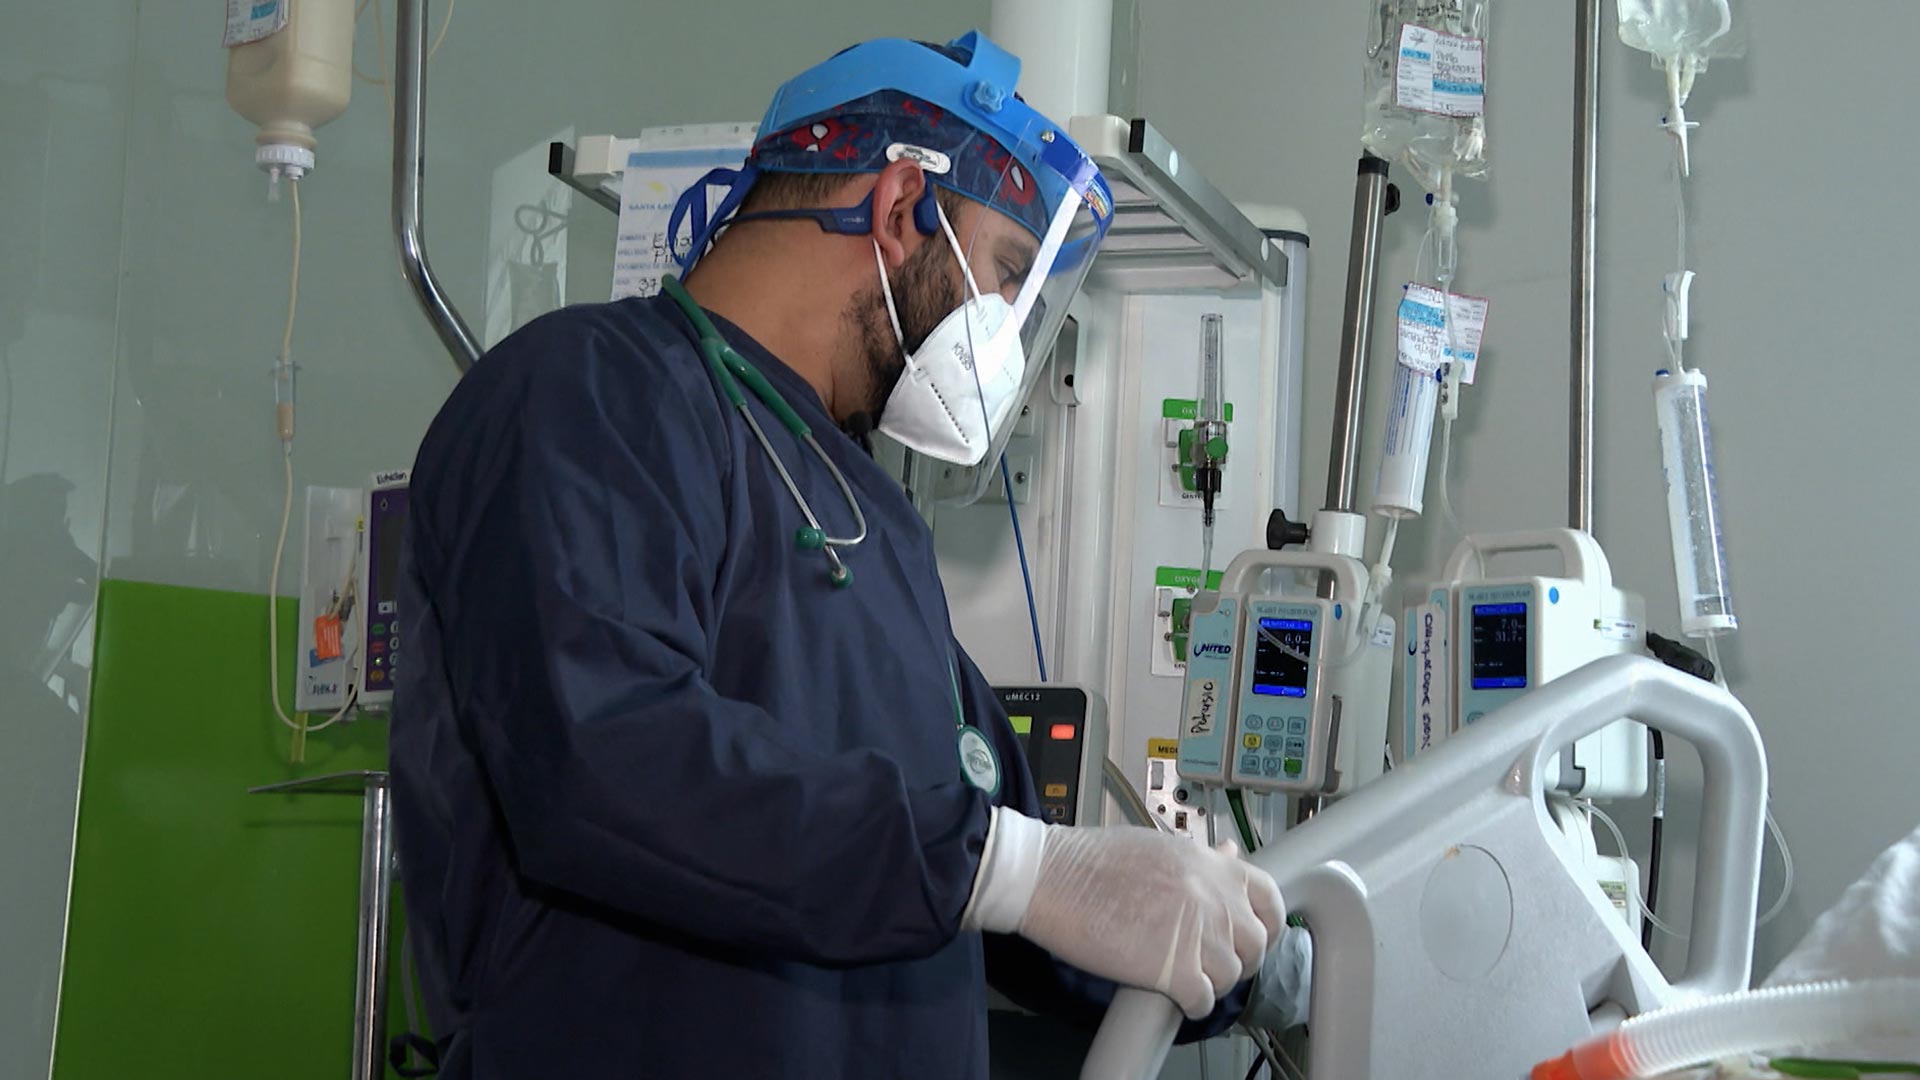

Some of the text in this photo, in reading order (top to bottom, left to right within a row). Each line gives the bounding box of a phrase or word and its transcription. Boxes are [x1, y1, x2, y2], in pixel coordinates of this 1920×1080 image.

[952, 342, 972, 371] KN95
[1174, 575, 1201, 583] OXYG
[1194, 643, 1231, 657] UNITED
[1005, 691, 1041, 701] uMEC12
[1158, 746, 1178, 754] MEDI
